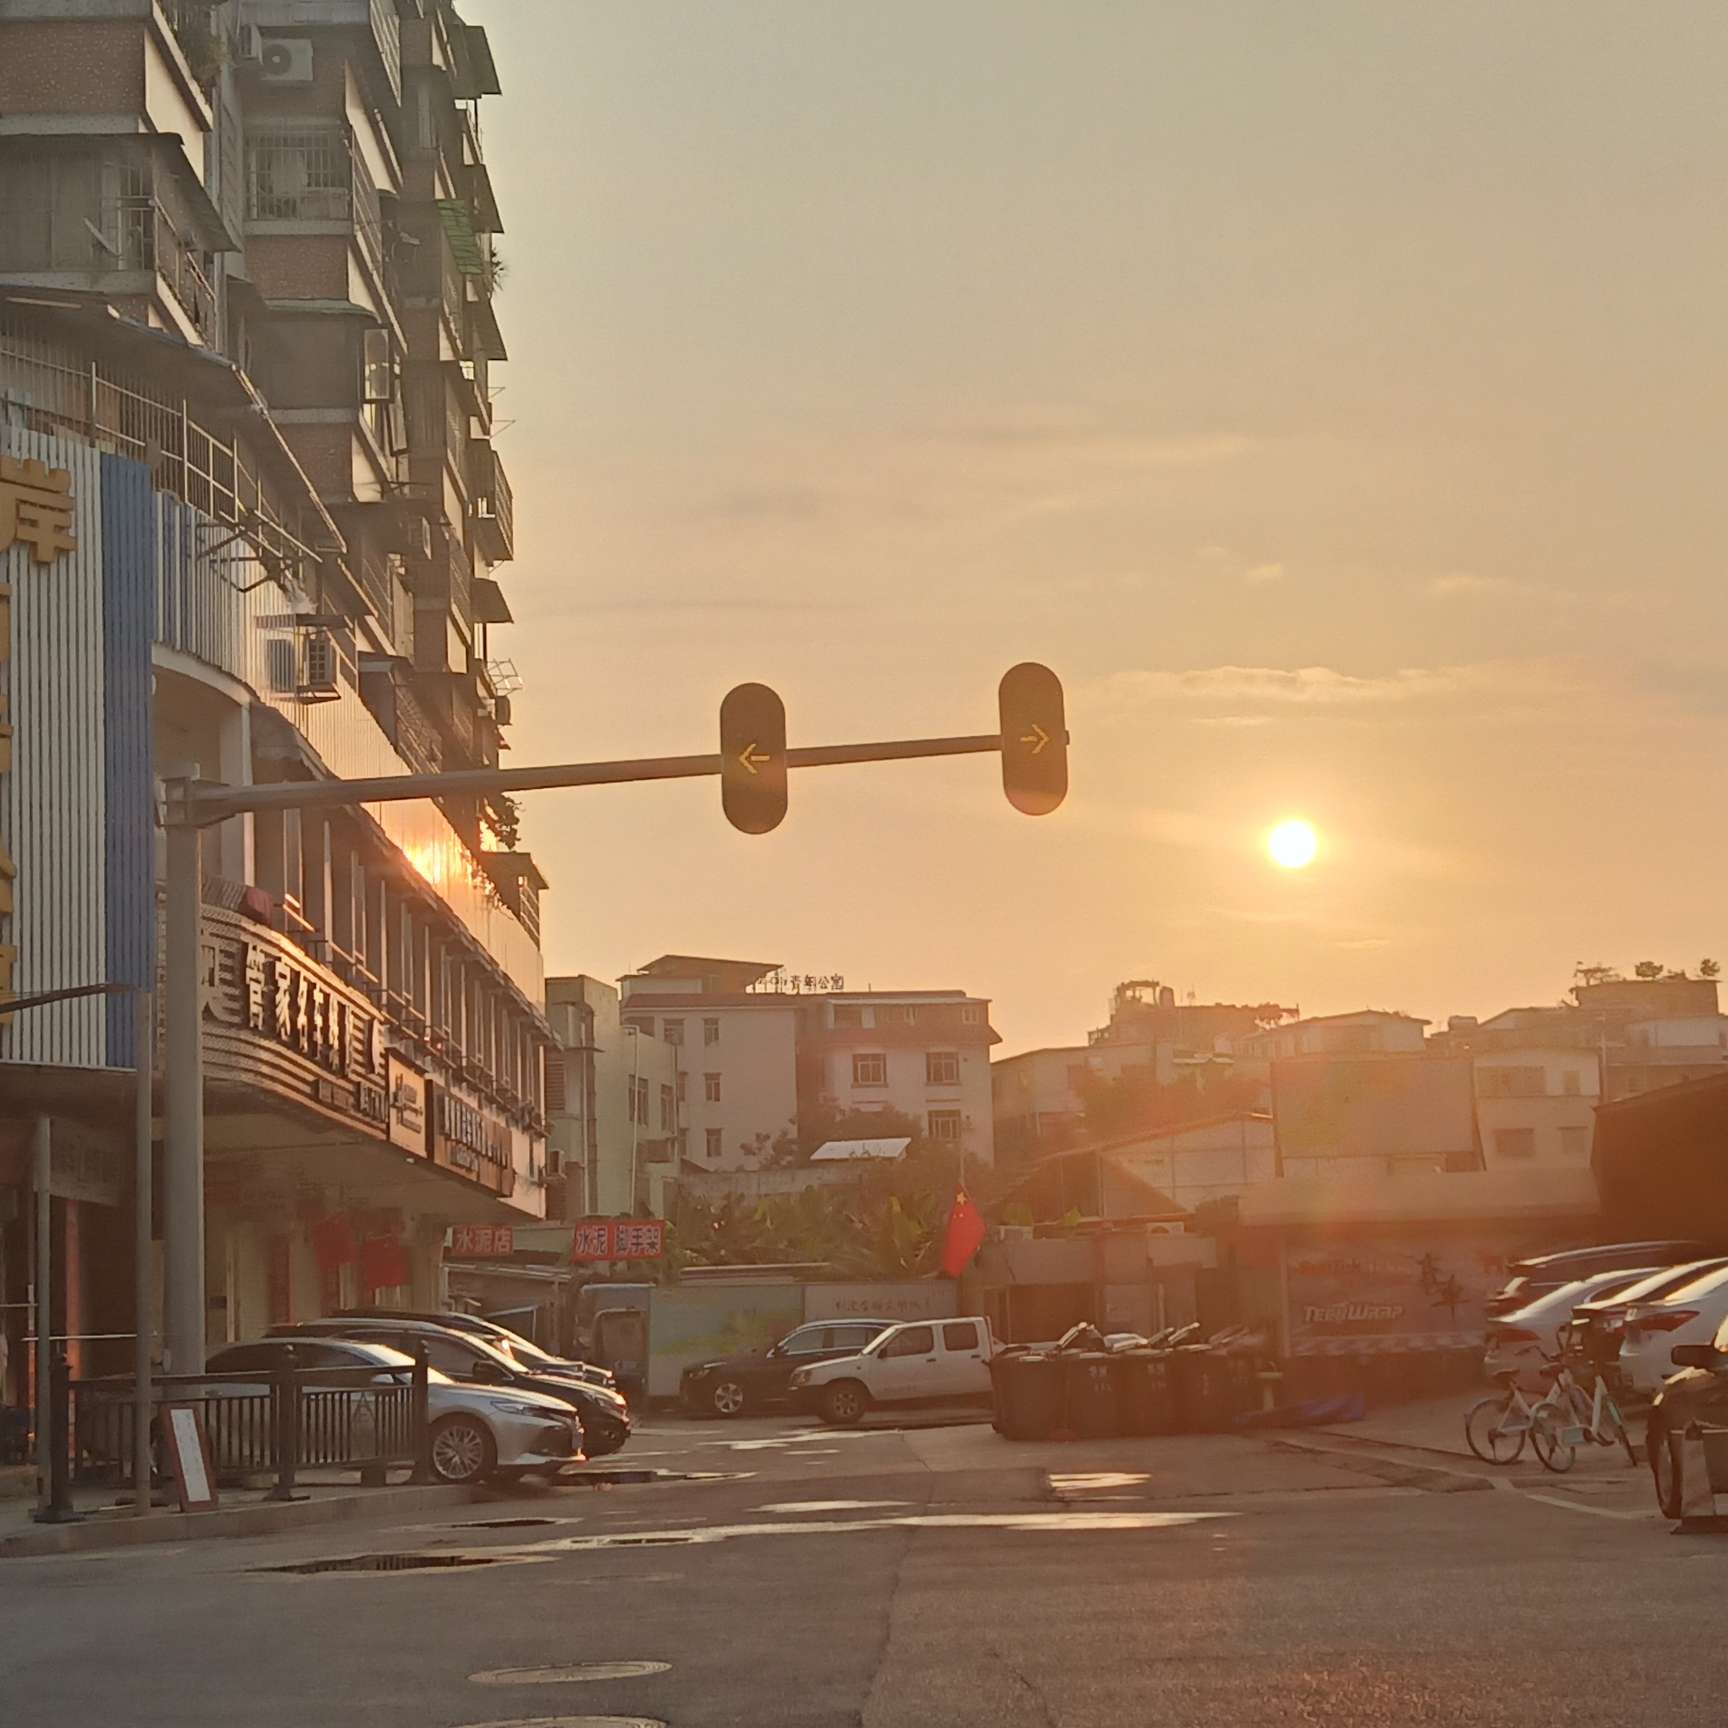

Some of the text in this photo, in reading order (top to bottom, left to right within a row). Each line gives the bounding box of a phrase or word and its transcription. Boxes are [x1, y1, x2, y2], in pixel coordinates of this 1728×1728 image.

[456, 1228, 511, 1253] 水泥店
[576, 1224, 608, 1256] 水泥
